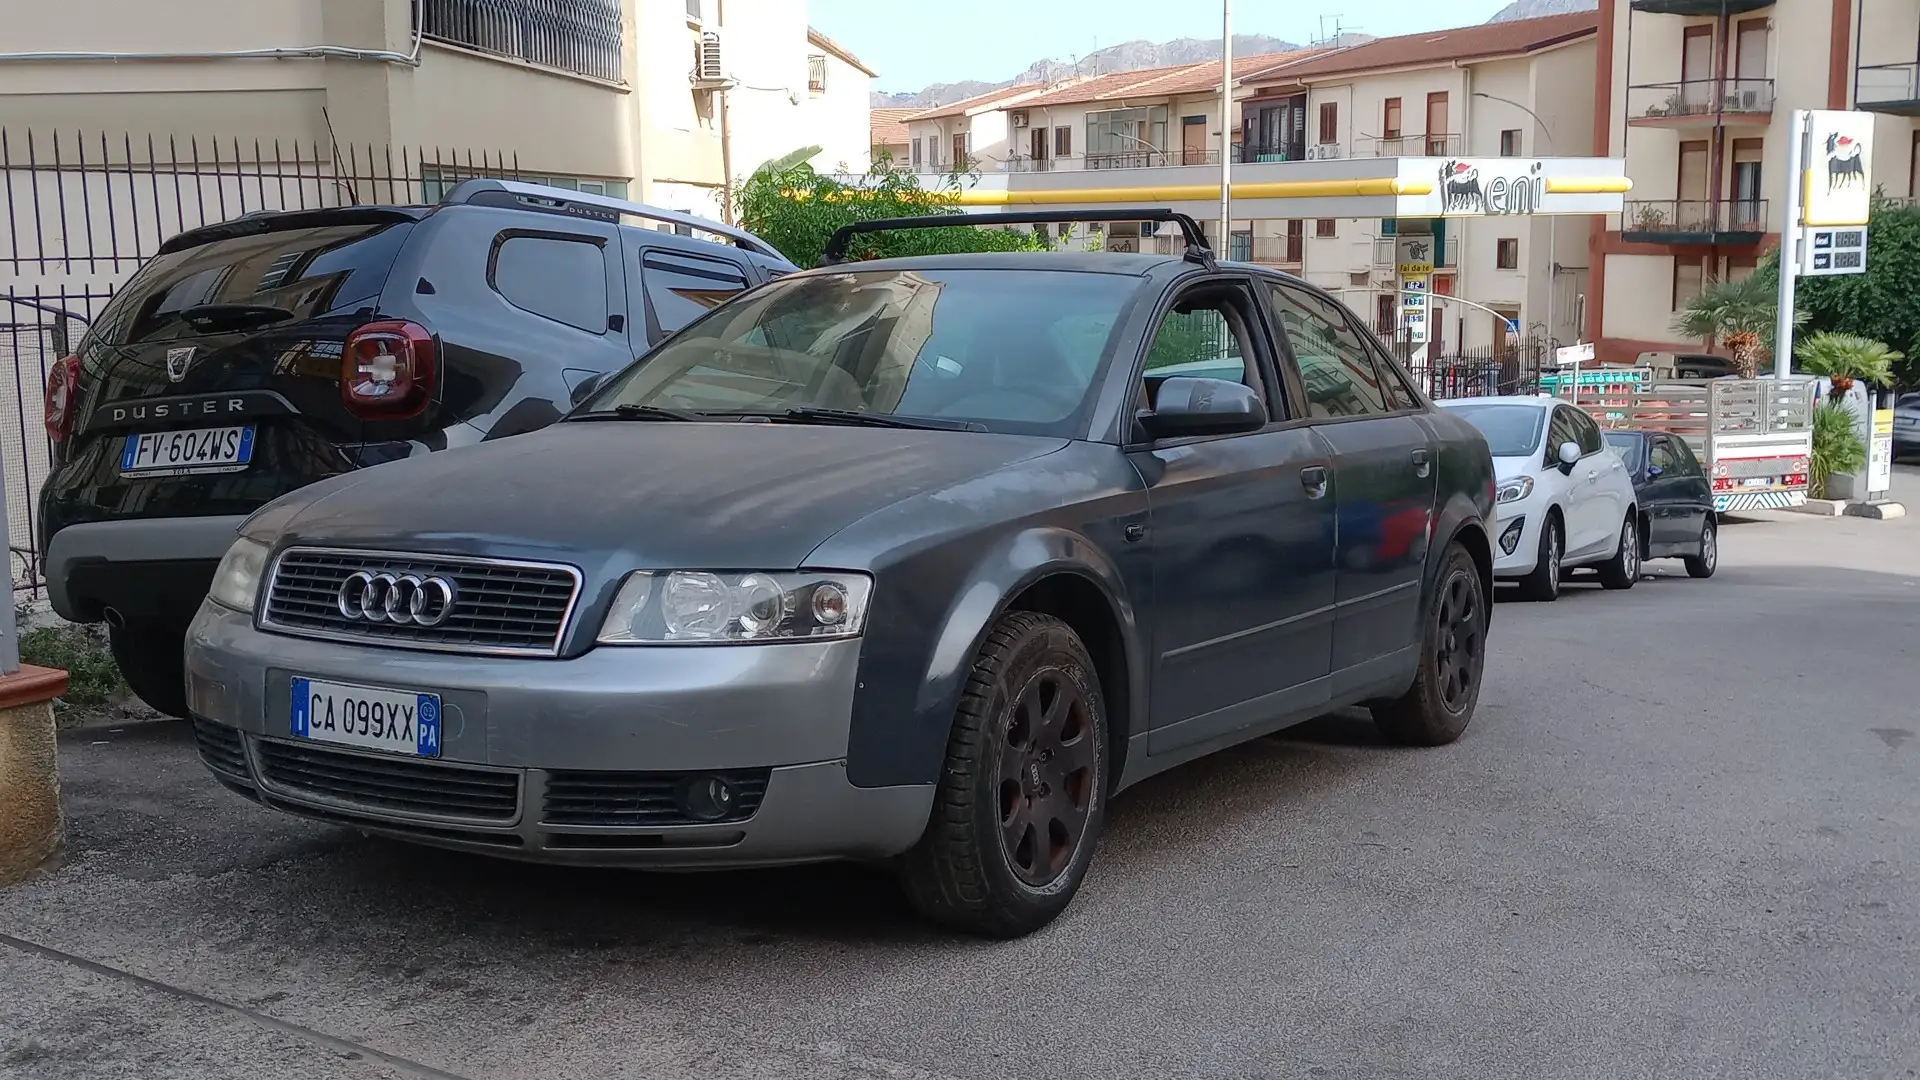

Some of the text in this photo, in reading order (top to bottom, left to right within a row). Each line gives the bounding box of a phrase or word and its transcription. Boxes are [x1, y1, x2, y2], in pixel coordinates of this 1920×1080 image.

[1486, 161, 1542, 214] eni
[569, 207, 614, 219] DUSTER
[113, 399, 245, 421] DUSTER
[311, 693, 336, 732] CA
[343, 698, 414, 742] 099XX
[419, 723, 437, 747] PA
